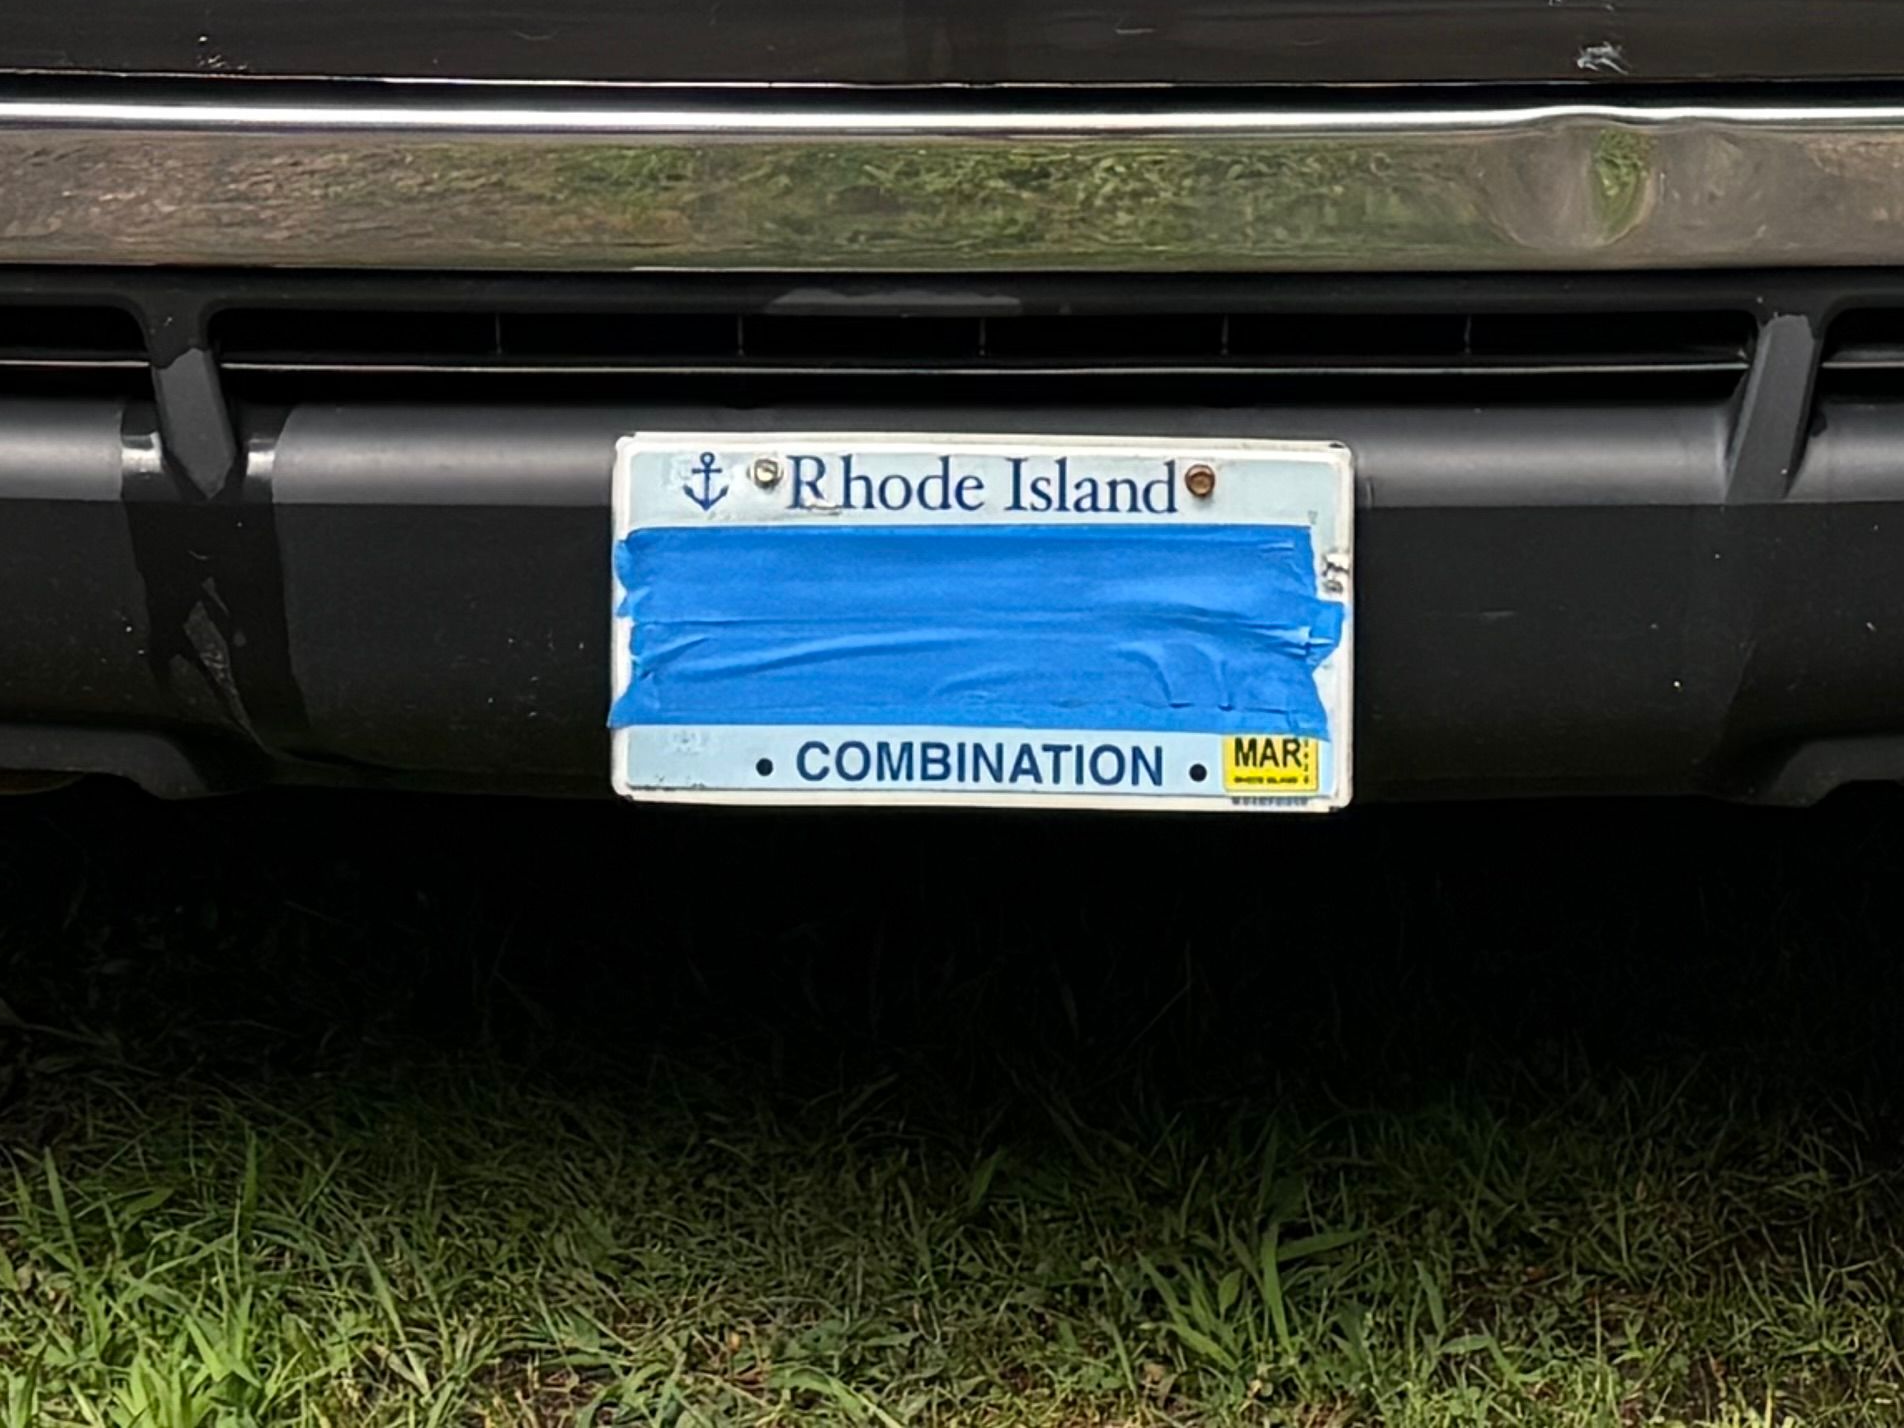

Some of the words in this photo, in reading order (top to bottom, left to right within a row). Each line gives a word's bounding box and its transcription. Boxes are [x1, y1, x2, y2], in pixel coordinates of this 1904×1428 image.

[786, 453, 985, 513] Rhode
[1004, 456, 1177, 514] Island
[795, 740, 1164, 787] COMBINATION
[1234, 737, 1302, 768] MAR
